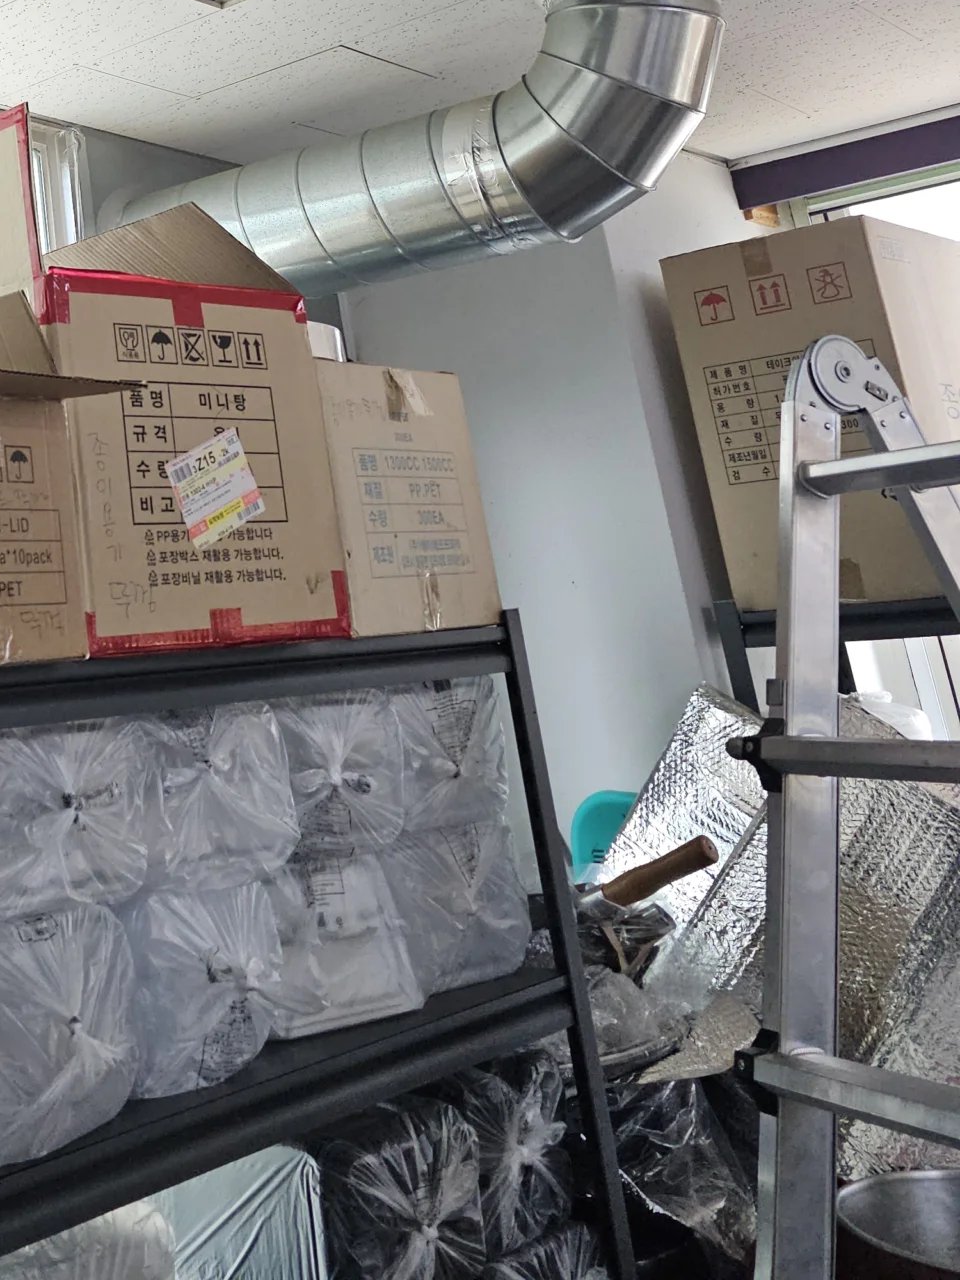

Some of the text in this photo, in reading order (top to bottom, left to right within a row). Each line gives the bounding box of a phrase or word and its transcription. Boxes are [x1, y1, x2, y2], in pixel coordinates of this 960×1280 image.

[709, 364, 747, 380] 제품명
[713, 381, 751, 396] 허가번호
[129, 390, 246, 412] 품명 미니탕
[716, 398, 754, 413] 용량
[720, 415, 758, 429] 재질
[132, 425, 167, 443] 규격
[724, 432, 762, 447] 수량
[732, 466, 771, 481] 검수
[139, 496, 175, 515] 비고
[159, 547, 284, 564] 포장박스 재활용 가능합니다.
[161, 568, 287, 586] 포장비닐 재활용 가능합니다.
